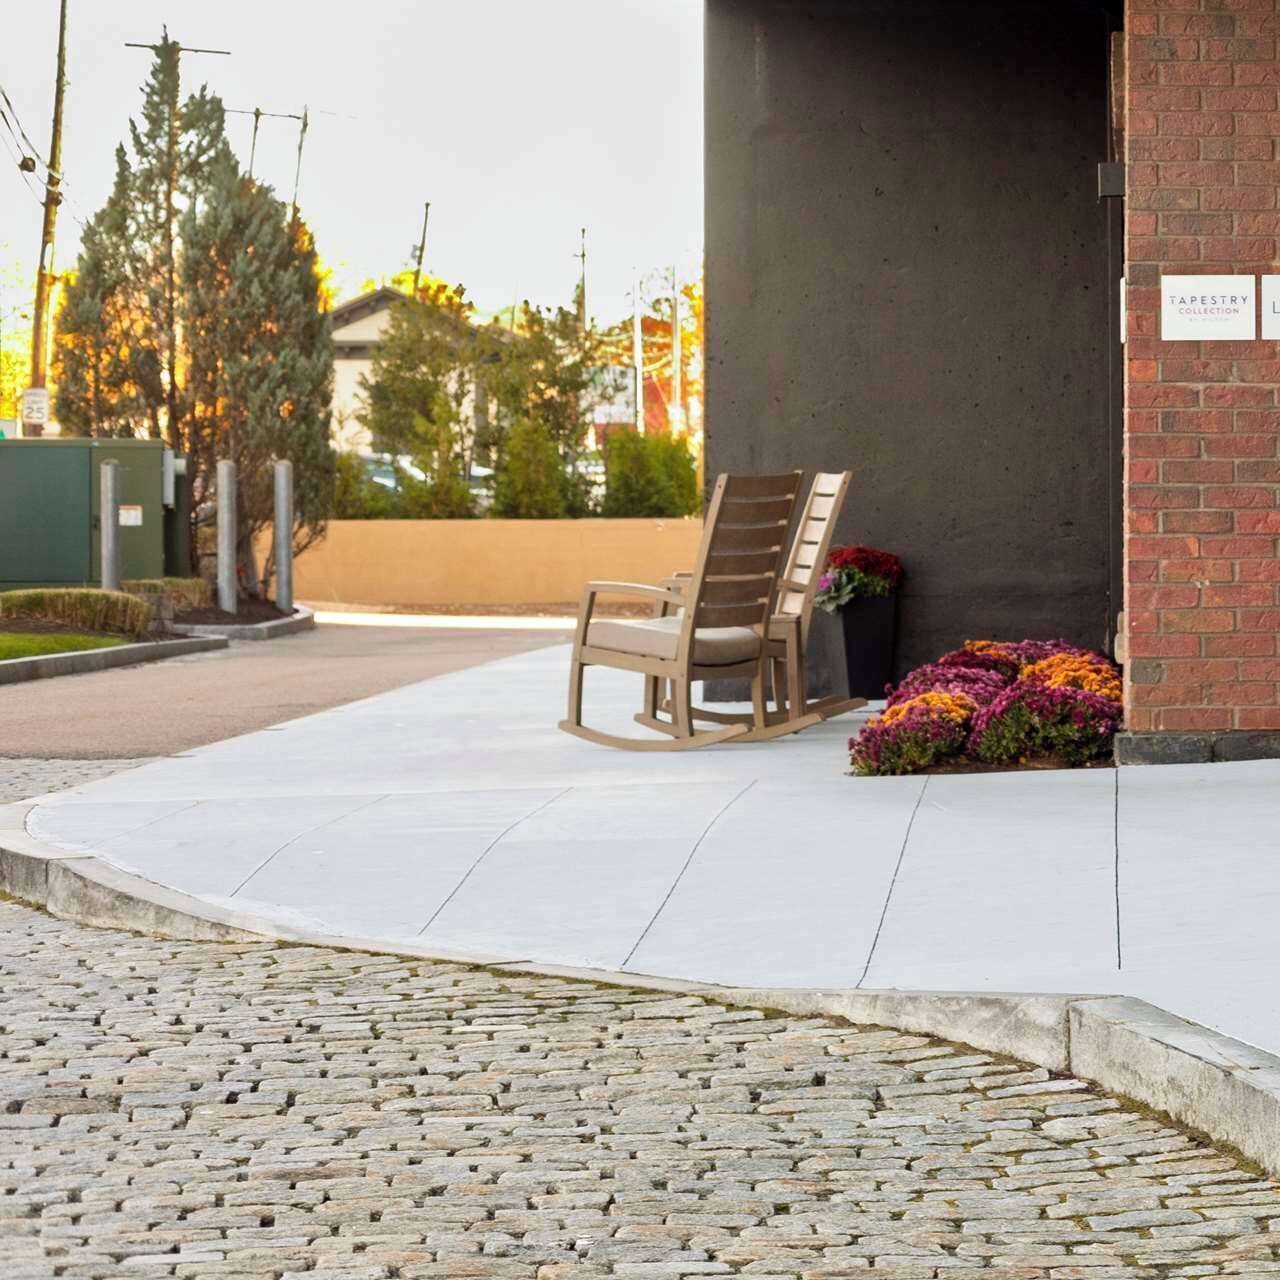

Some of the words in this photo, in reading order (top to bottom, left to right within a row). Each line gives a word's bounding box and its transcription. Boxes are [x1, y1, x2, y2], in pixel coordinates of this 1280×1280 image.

[1169, 295, 1248, 305] TAPESTRY
[1178, 307, 1240, 315] COLLECTION
[25, 406, 45, 420] 25
